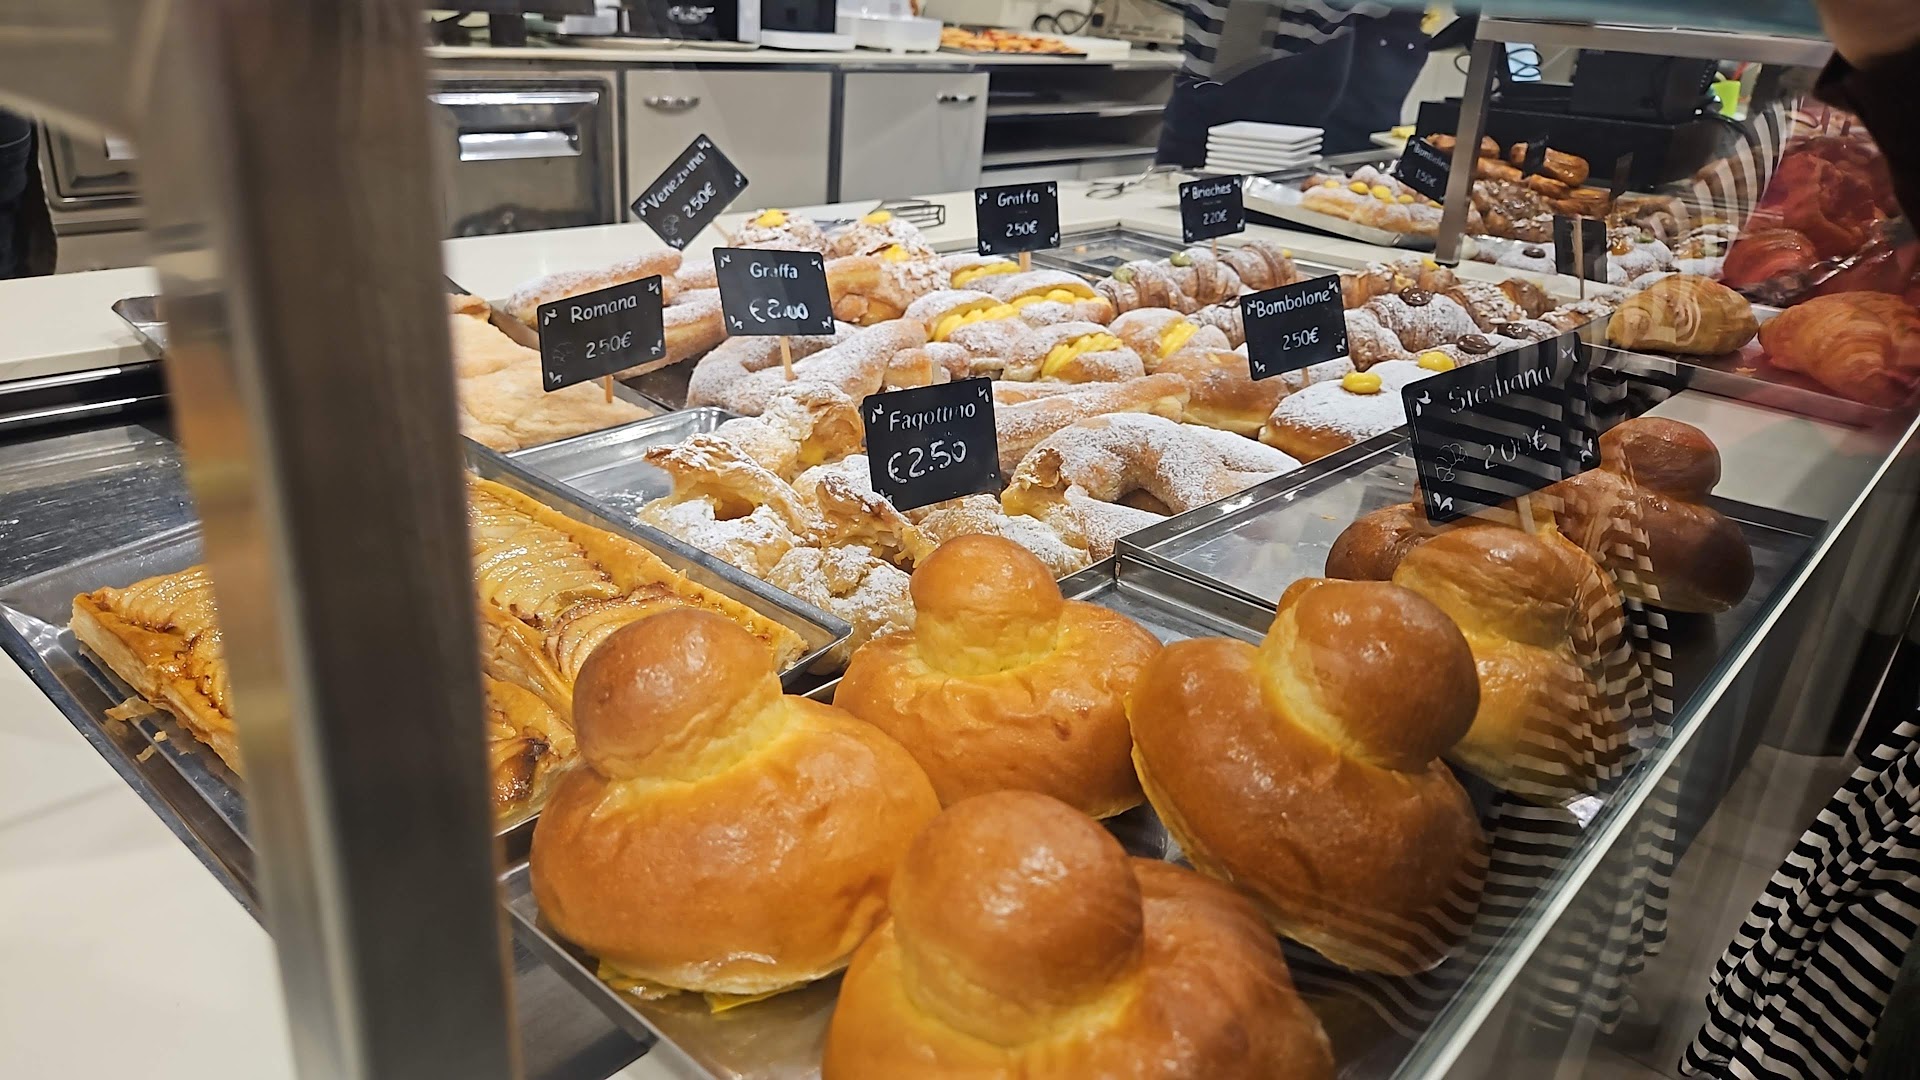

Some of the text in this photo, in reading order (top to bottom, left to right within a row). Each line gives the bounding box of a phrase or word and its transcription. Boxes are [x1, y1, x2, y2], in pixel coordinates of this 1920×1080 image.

[997, 189, 1039, 208] Graffa
[749, 261, 799, 279] Graffa
[570, 295, 638, 323] Romana
[1256, 290, 1331, 318] Bombolone
[1448, 366, 1551, 414] Siciliana
[887, 439, 967, 484] €2.50
